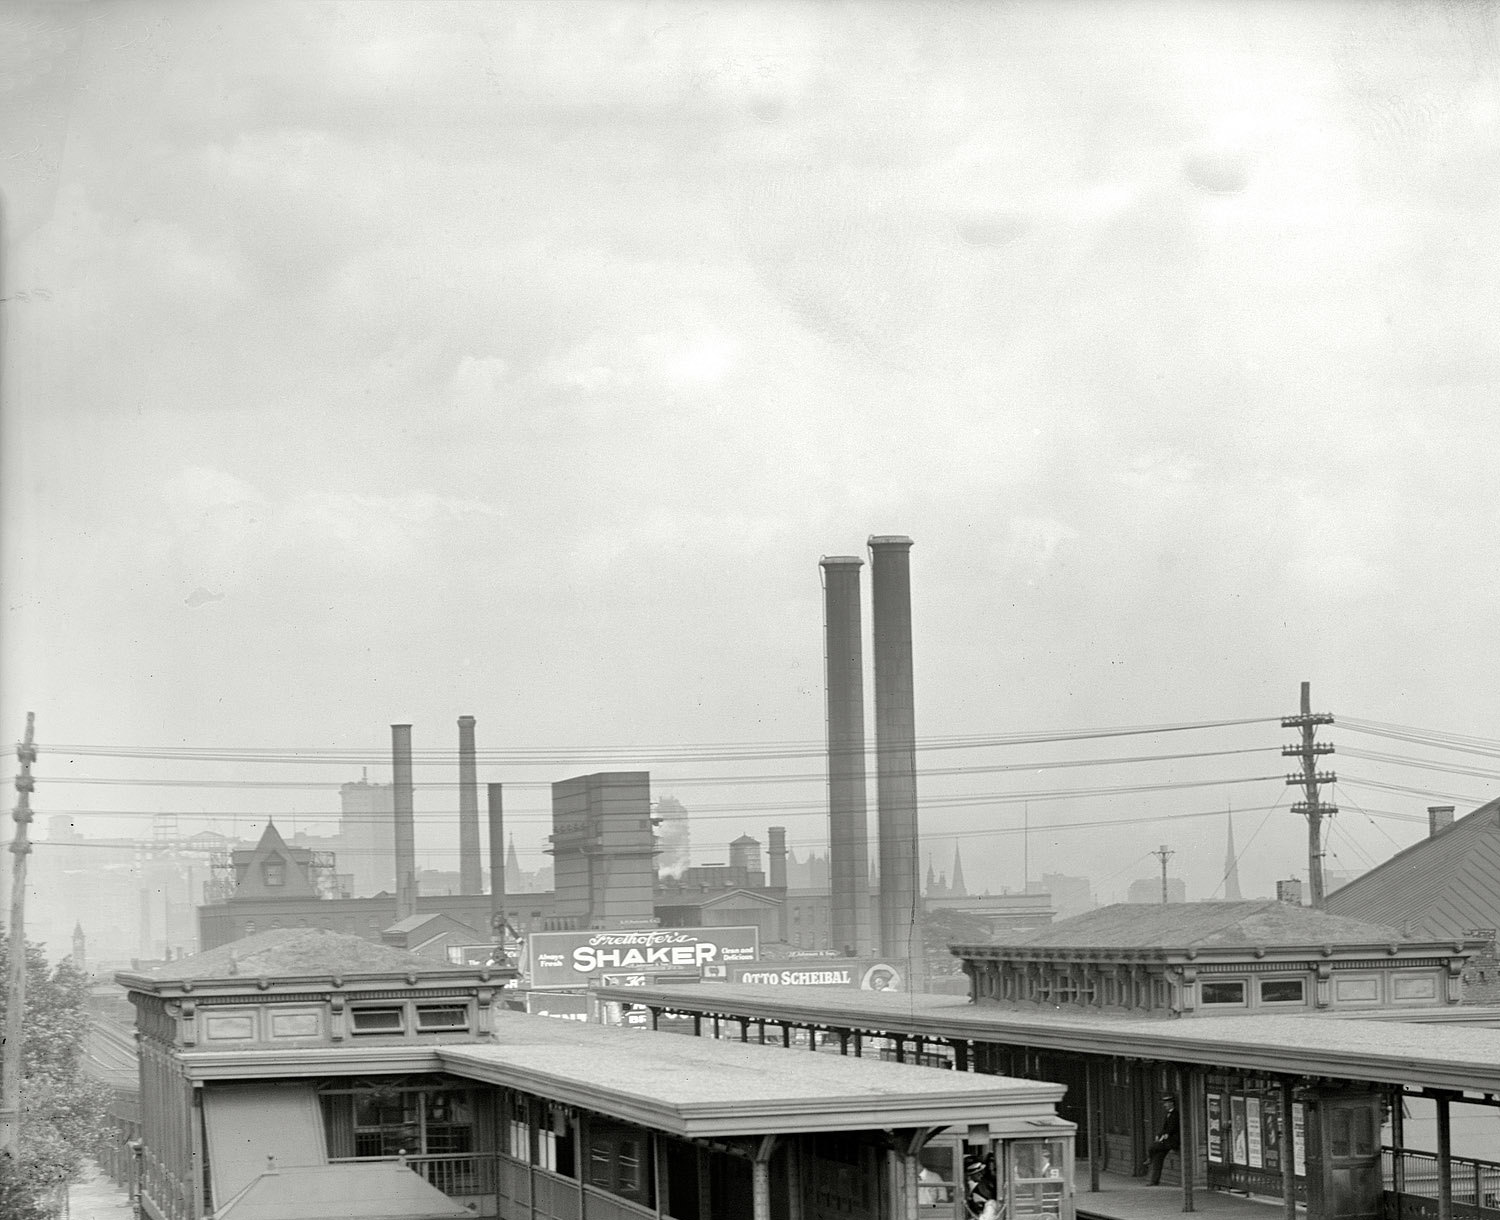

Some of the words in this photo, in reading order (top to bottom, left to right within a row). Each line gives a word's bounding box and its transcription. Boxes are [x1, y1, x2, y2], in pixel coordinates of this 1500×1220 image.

[573, 943, 717, 972] SHAKER
[723, 953, 754, 961] Delicious
[742, 972, 779, 985] OTTO
[781, 970, 850, 986] SCHEIBAL
